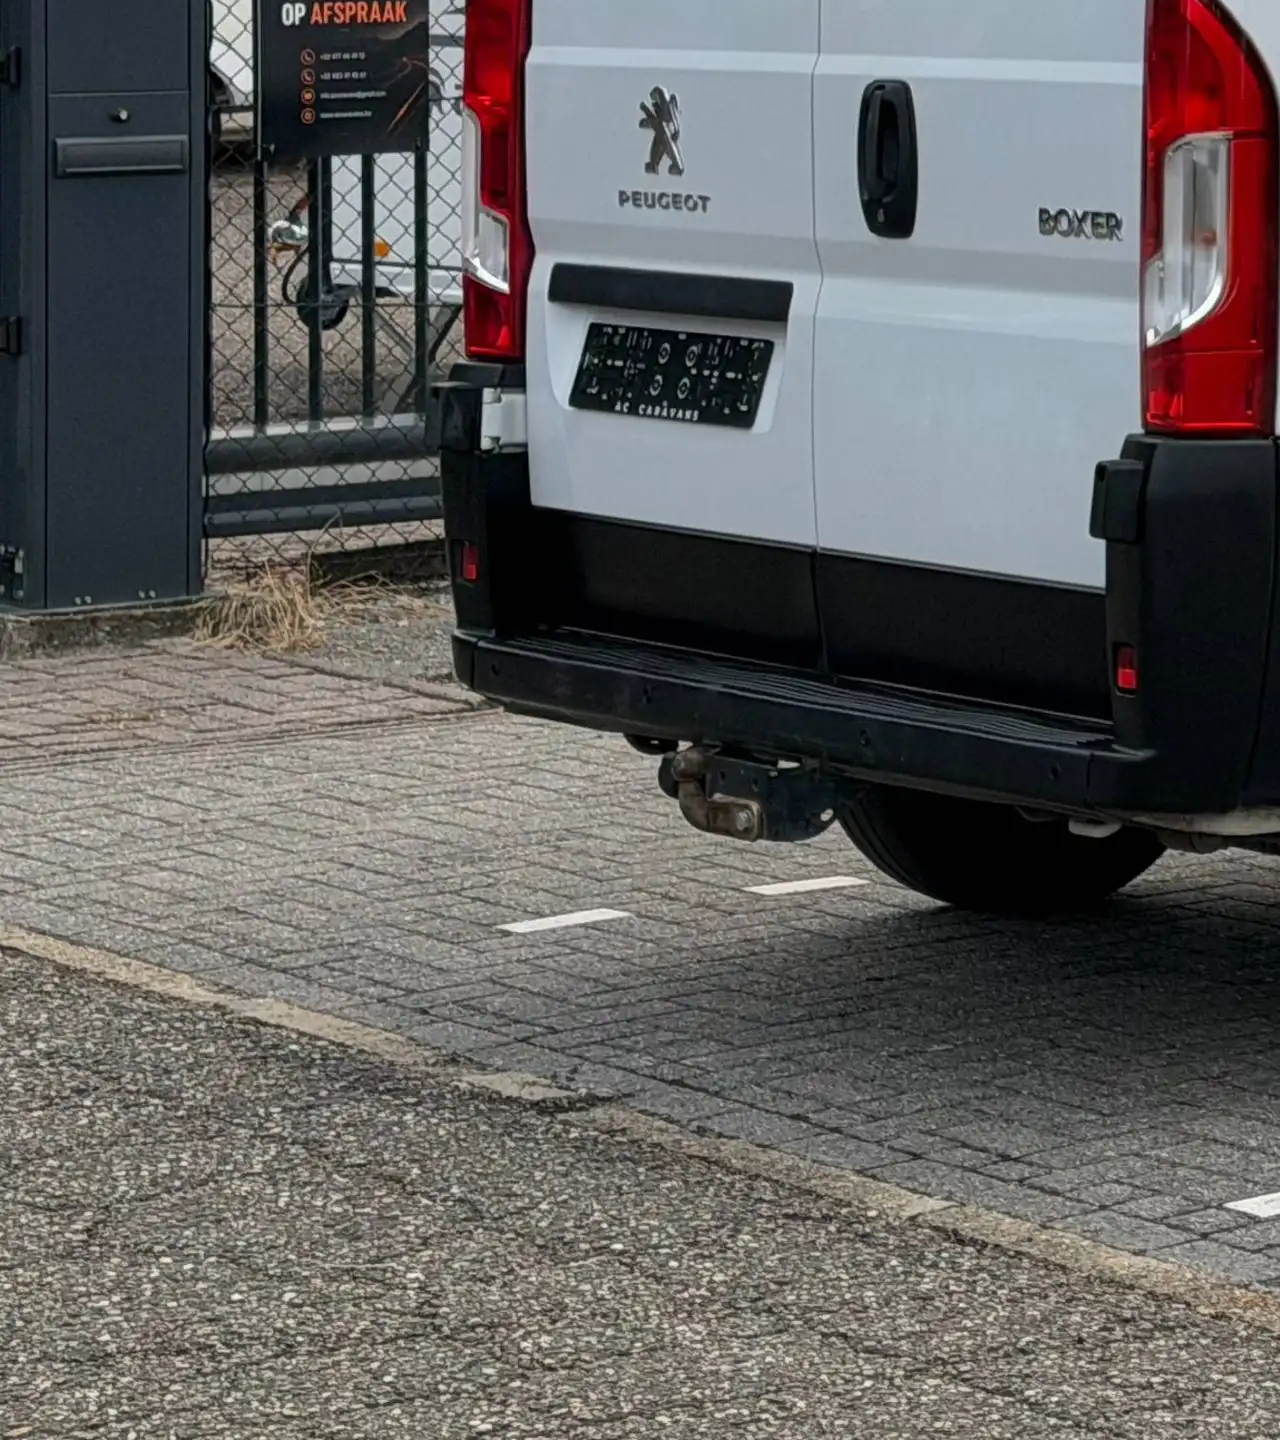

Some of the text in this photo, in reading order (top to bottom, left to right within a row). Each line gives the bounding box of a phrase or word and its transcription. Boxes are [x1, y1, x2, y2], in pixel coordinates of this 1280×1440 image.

[281, 1, 407, 27] OP AFSPRAAK
[618, 190, 711, 213] PEUGEOT
[1038, 207, 1124, 241] BOXER
[614, 400, 631, 413] AC
